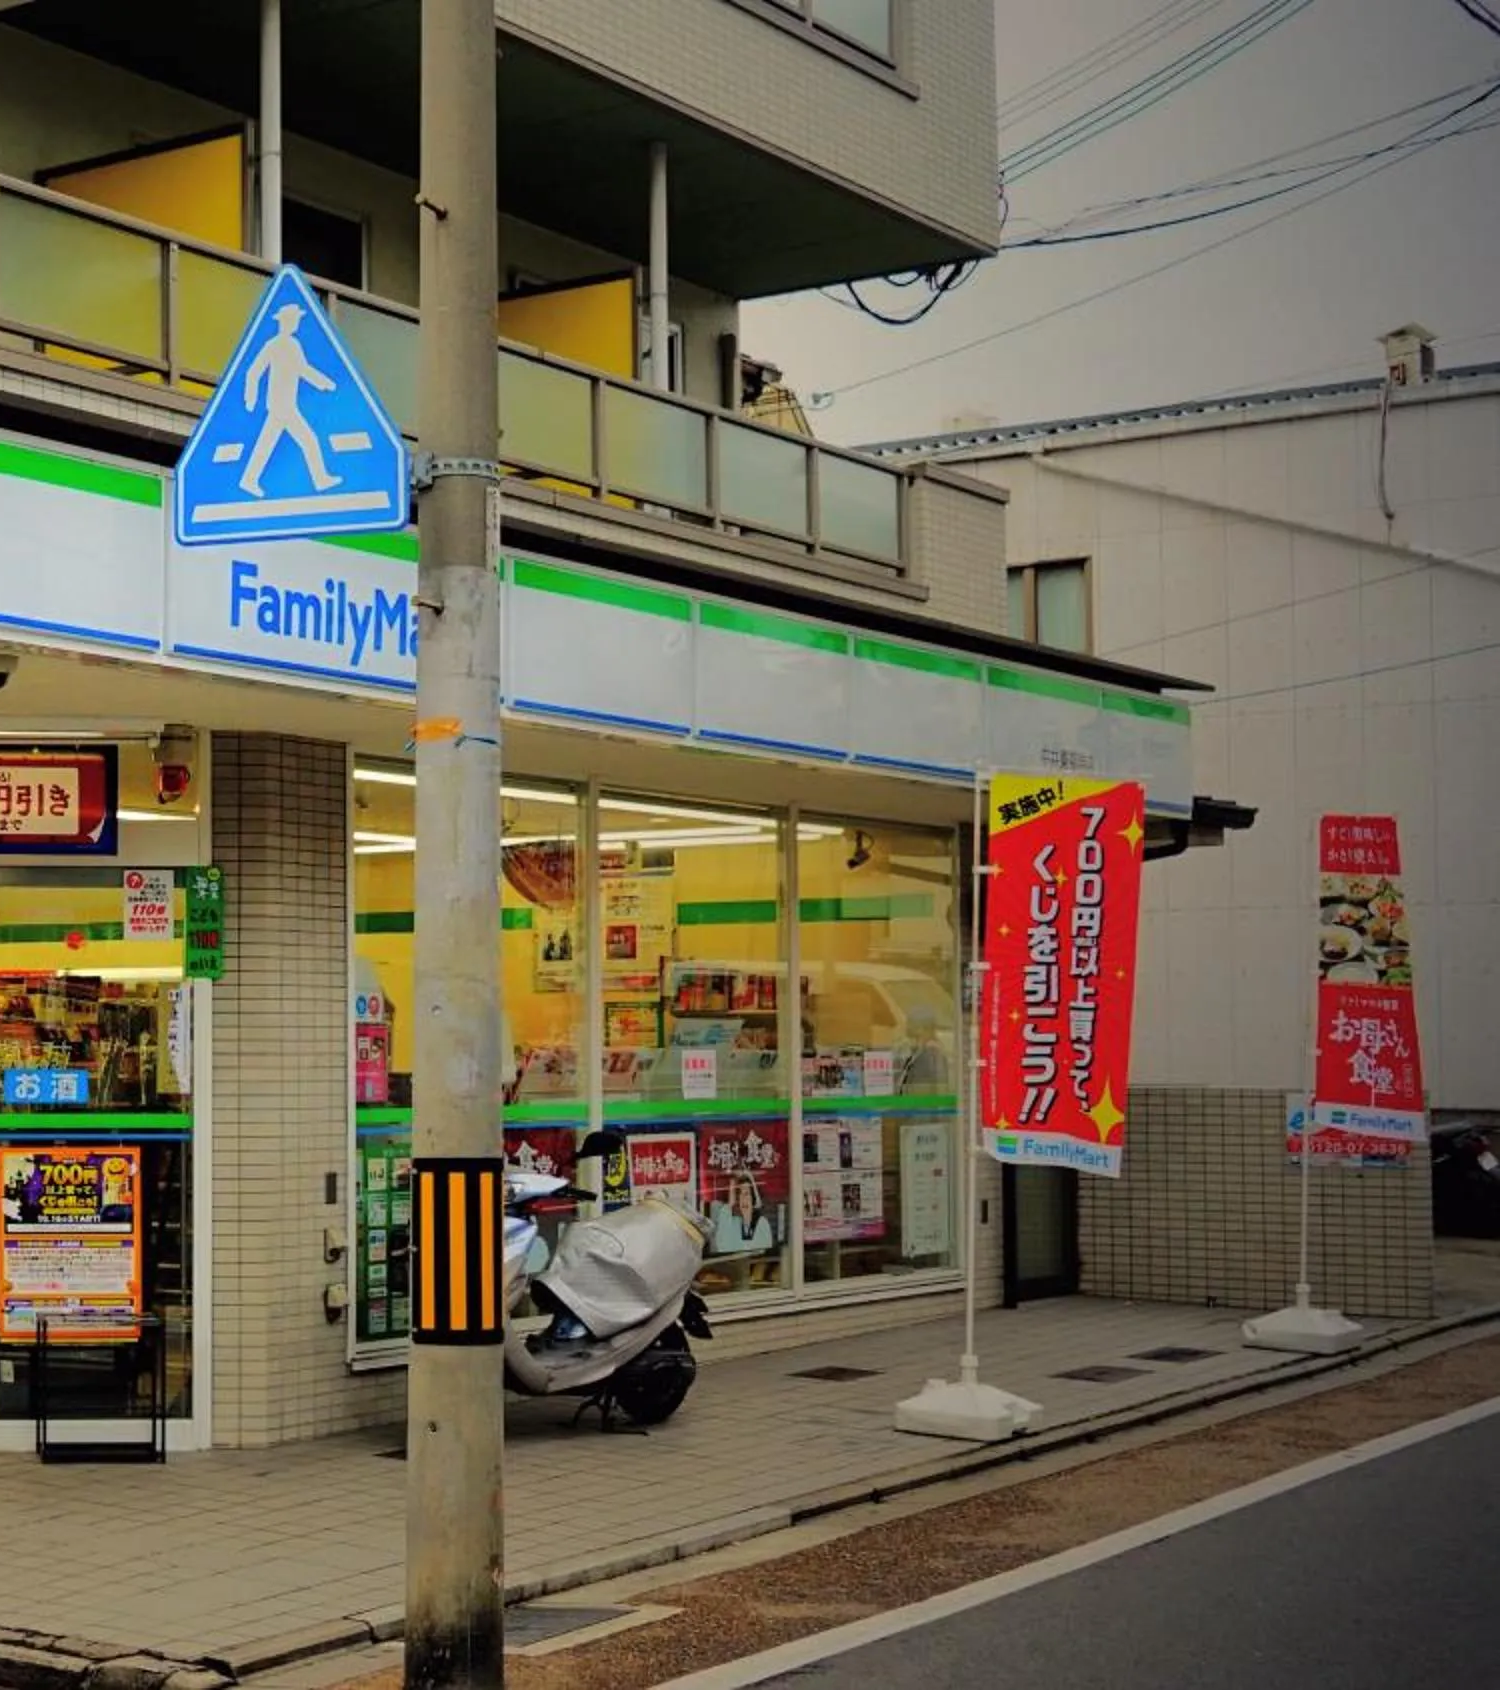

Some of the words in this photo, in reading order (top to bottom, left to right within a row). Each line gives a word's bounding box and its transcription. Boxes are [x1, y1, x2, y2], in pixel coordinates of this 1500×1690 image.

[231, 560, 417, 666] FamilyM
[997, 779, 1065, 825] 実施中!
[14, 1073, 79, 1100] お酒
[1023, 1138, 1109, 1168] FamilyMart
[39, 1164, 99, 1185] 700円
